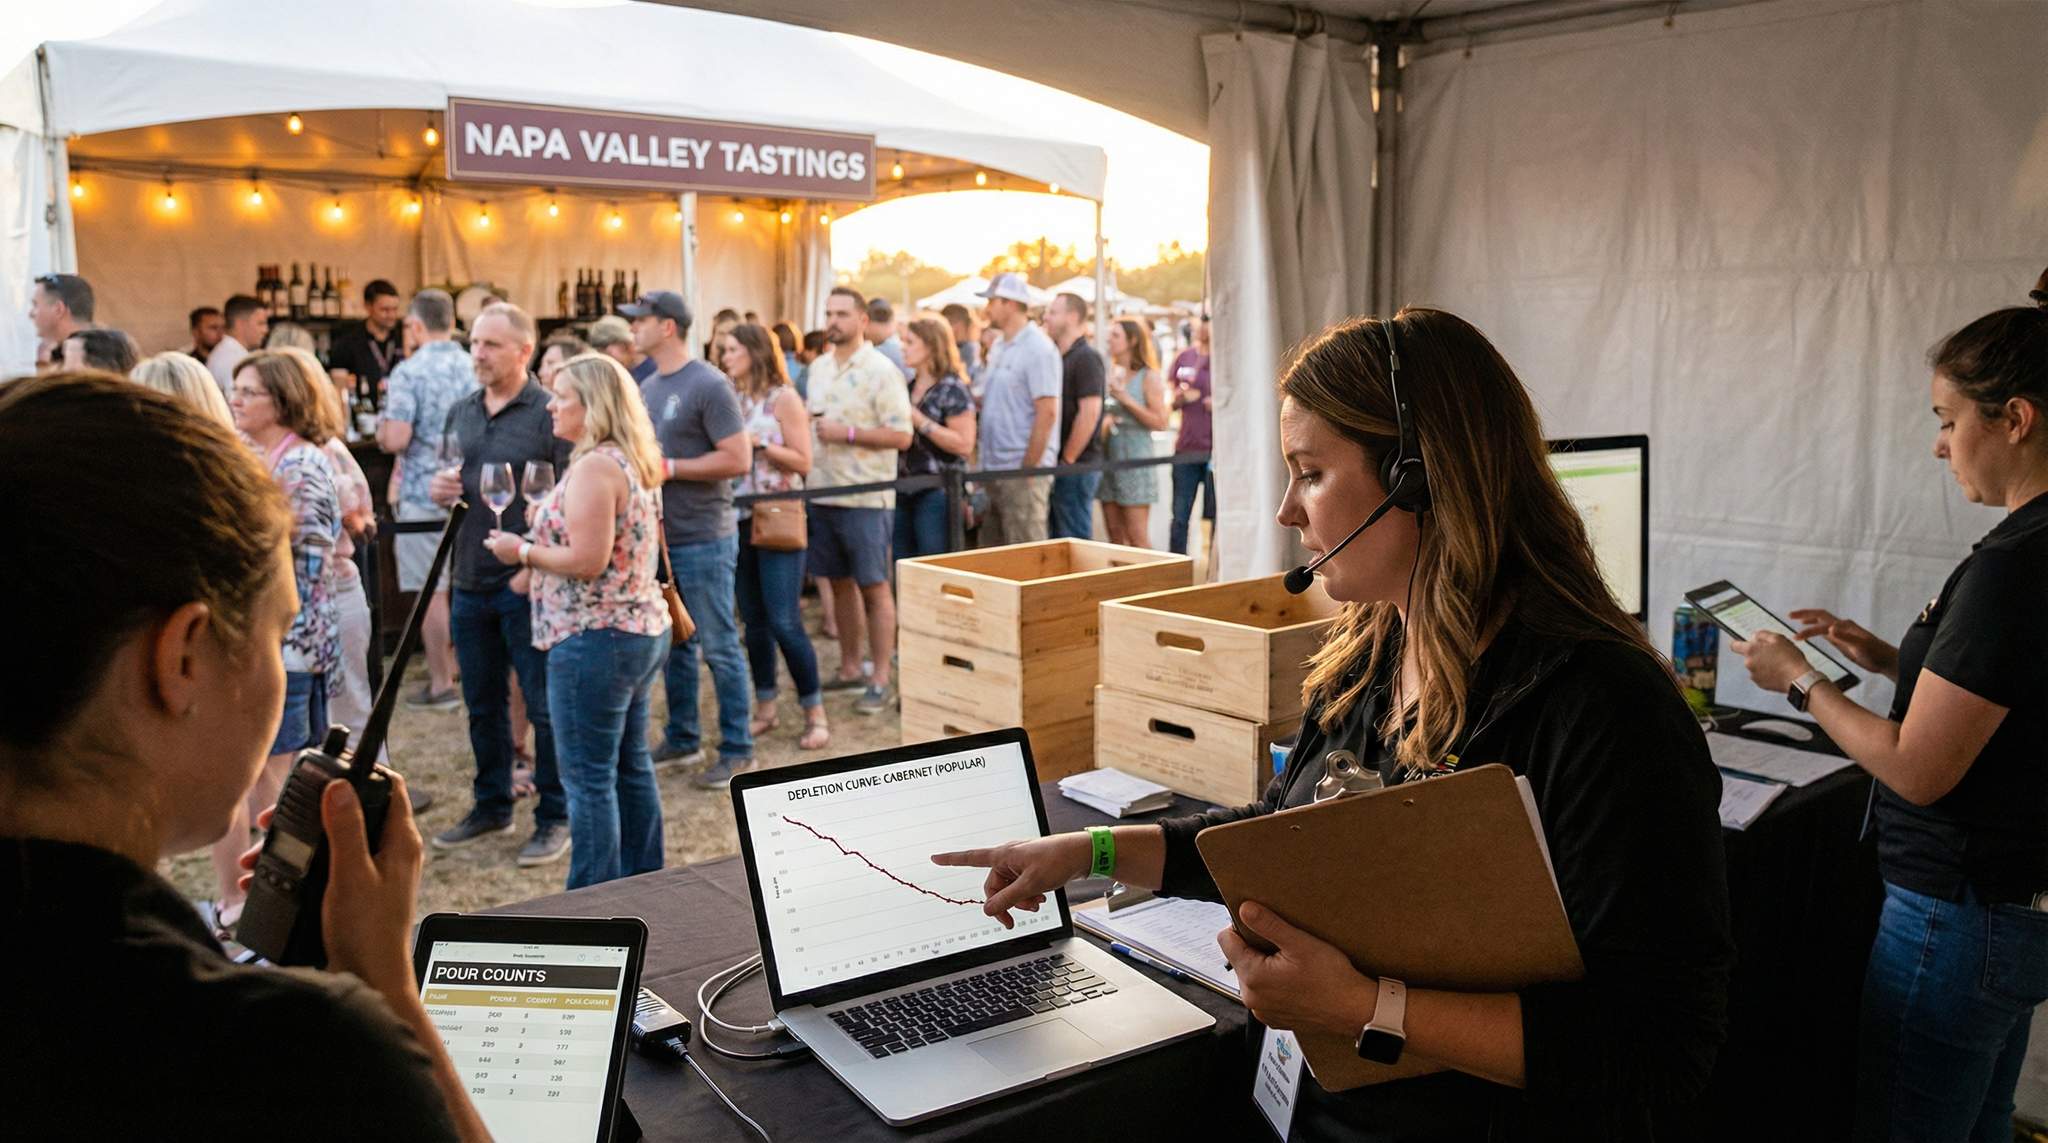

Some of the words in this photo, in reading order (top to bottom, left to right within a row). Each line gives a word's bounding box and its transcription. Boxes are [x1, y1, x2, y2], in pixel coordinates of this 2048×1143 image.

[465, 121, 571, 161] NAPA
[579, 130, 713, 170] VALLEY
[719, 141, 867, 182] TASTINGS
[787, 782, 844, 801] DEPLETION
[845, 775, 882, 792] CURVE:
[883, 766, 933, 785] CABERNET
[935, 756, 986, 778] (POPULAR)
[435, 967, 478, 981] POUR
[482, 968, 547, 983] COUNTS
